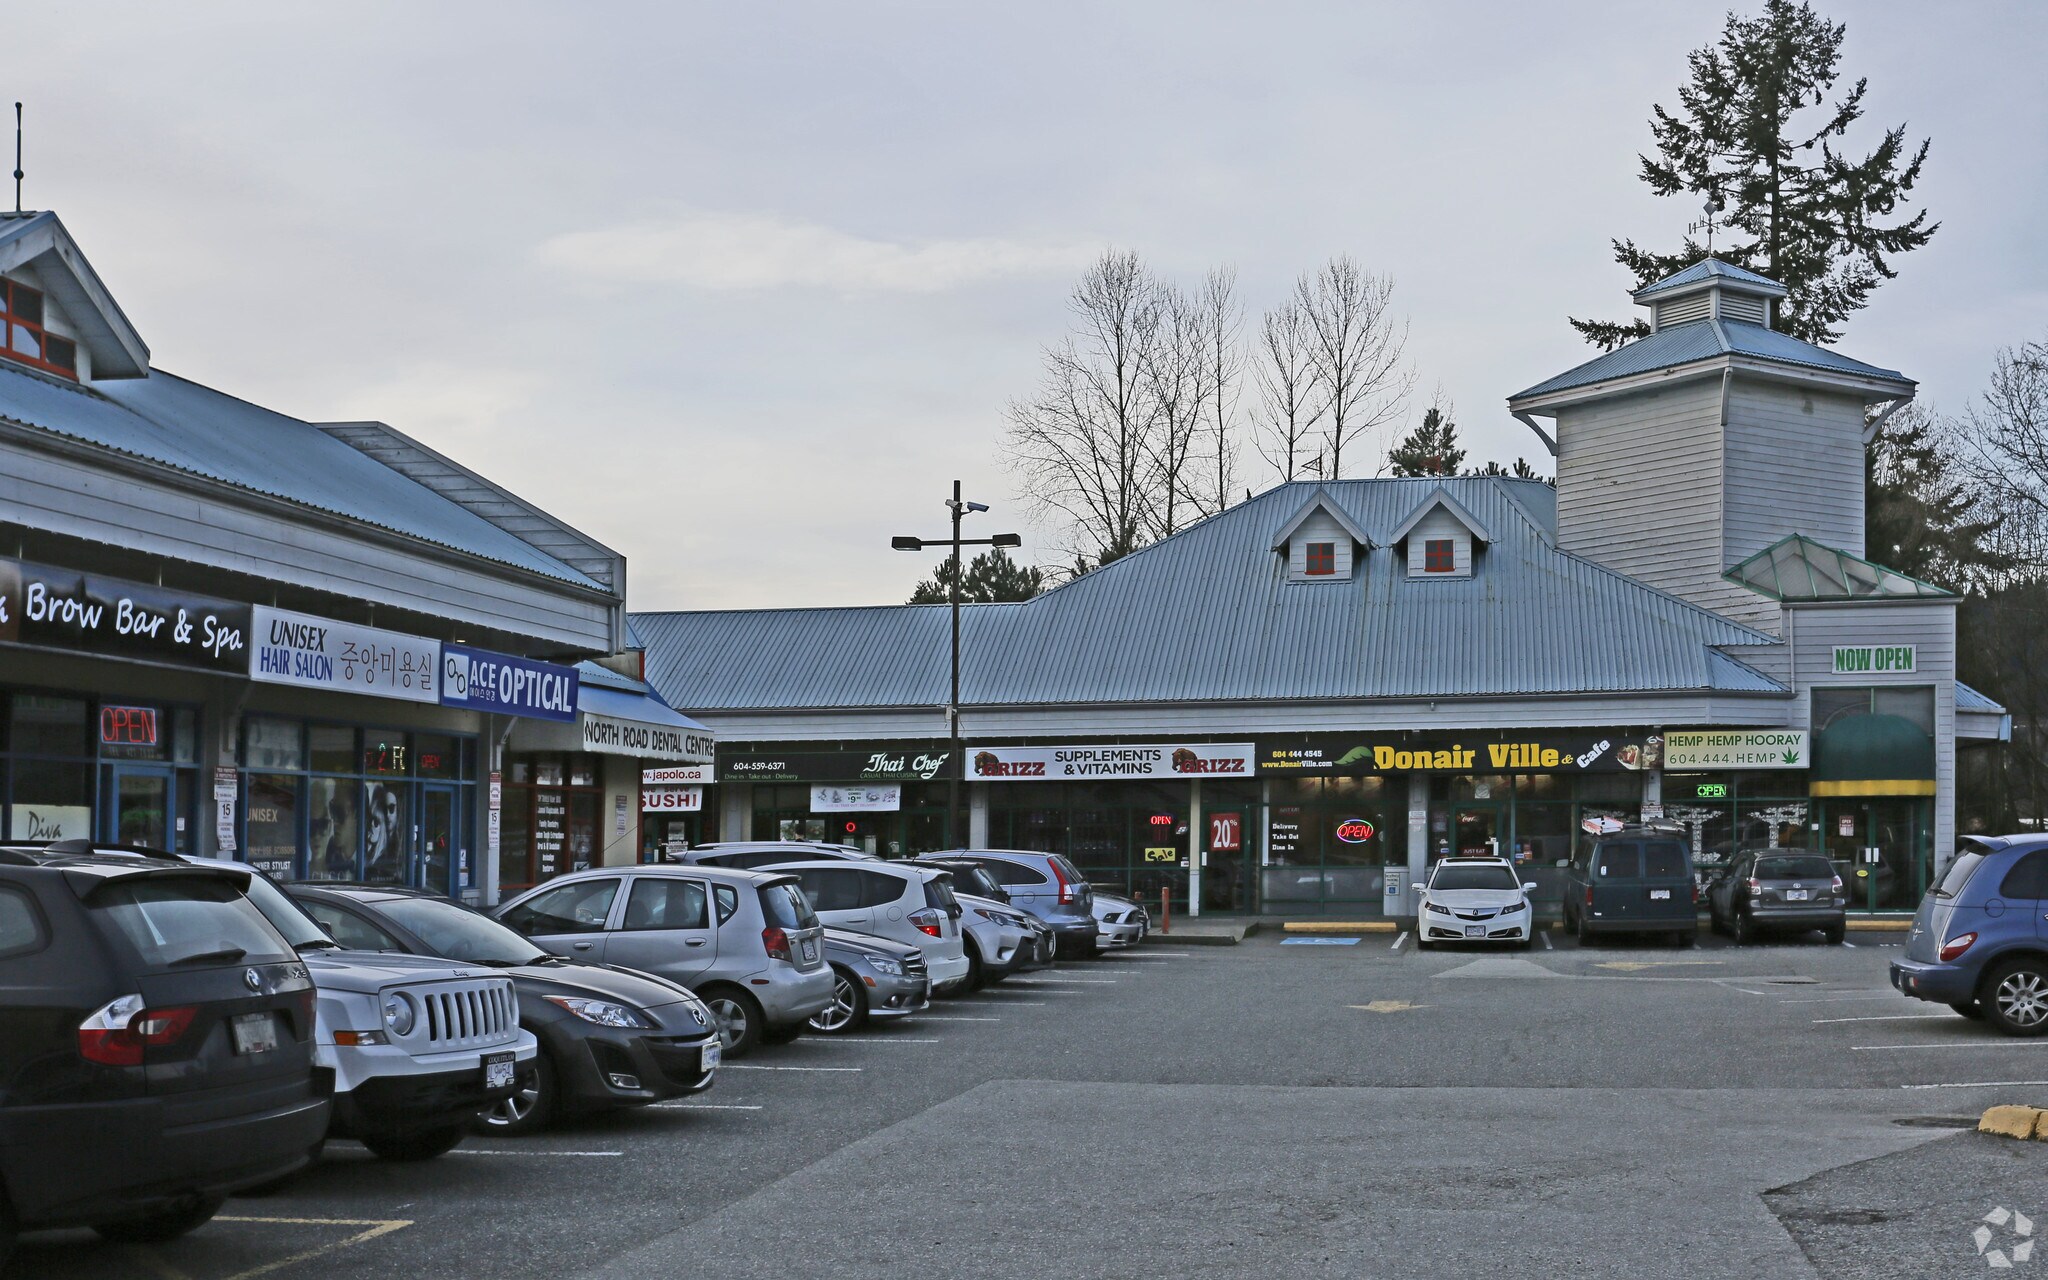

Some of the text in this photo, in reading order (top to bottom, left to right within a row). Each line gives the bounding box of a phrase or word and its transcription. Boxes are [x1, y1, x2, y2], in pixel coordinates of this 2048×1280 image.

[26, 582, 102, 629] Brow
[116, 598, 165, 638] Bar
[174, 609, 193, 644] &
[202, 615, 243, 658] Spa
[270, 619, 327, 653] UNISEX
[260, 646, 333, 682] HAIR SALON
[340, 641, 432, 690] 중앙미용실
[1835, 647, 1912, 671] NOW OPEN
[470, 660, 572, 713] ACE OPTICAL
[101, 707, 156, 743] OPEN
[585, 721, 714, 757] NORTH ROAD DENTAL CENTRE
[1669, 735, 1703, 747] HEMP
[1707, 735, 1742, 747] HEMP
[1745, 734, 1801, 747] HOORAY
[1055, 749, 1162, 762] SUPPLEMENTS
[1272, 750, 1322, 758] 604 444 4545
[1373, 739, 1610, 770] Donair Ville & Cafe
[1669, 753, 1777, 765] 604.444.HEMP
[733, 762, 786, 770] 604-559-6371
[863, 752, 949, 780] Thai Chef
[983, 761, 1046, 776] GRIZZ
[1064, 763, 1152, 775] & VITAMINS
[1181, 758, 1245, 774] GRIZZ
[1262, 760, 1333, 769] www.DonairVille.com
[775, 773, 799, 781] Delivery
[1697, 784, 1727, 797] OPEN
[641, 793, 697, 808] SUSHI
[222, 803, 231, 816] 15
[491, 812, 498, 823] 15
[1150, 815, 1171, 825] OPEN
[28, 810, 62, 840] Diva
[1339, 824, 1371, 838] OPEN
[1147, 849, 1173, 861] Sale
[272, 861, 292, 870] STYLIST
[292, 969, 308, 980] X3
